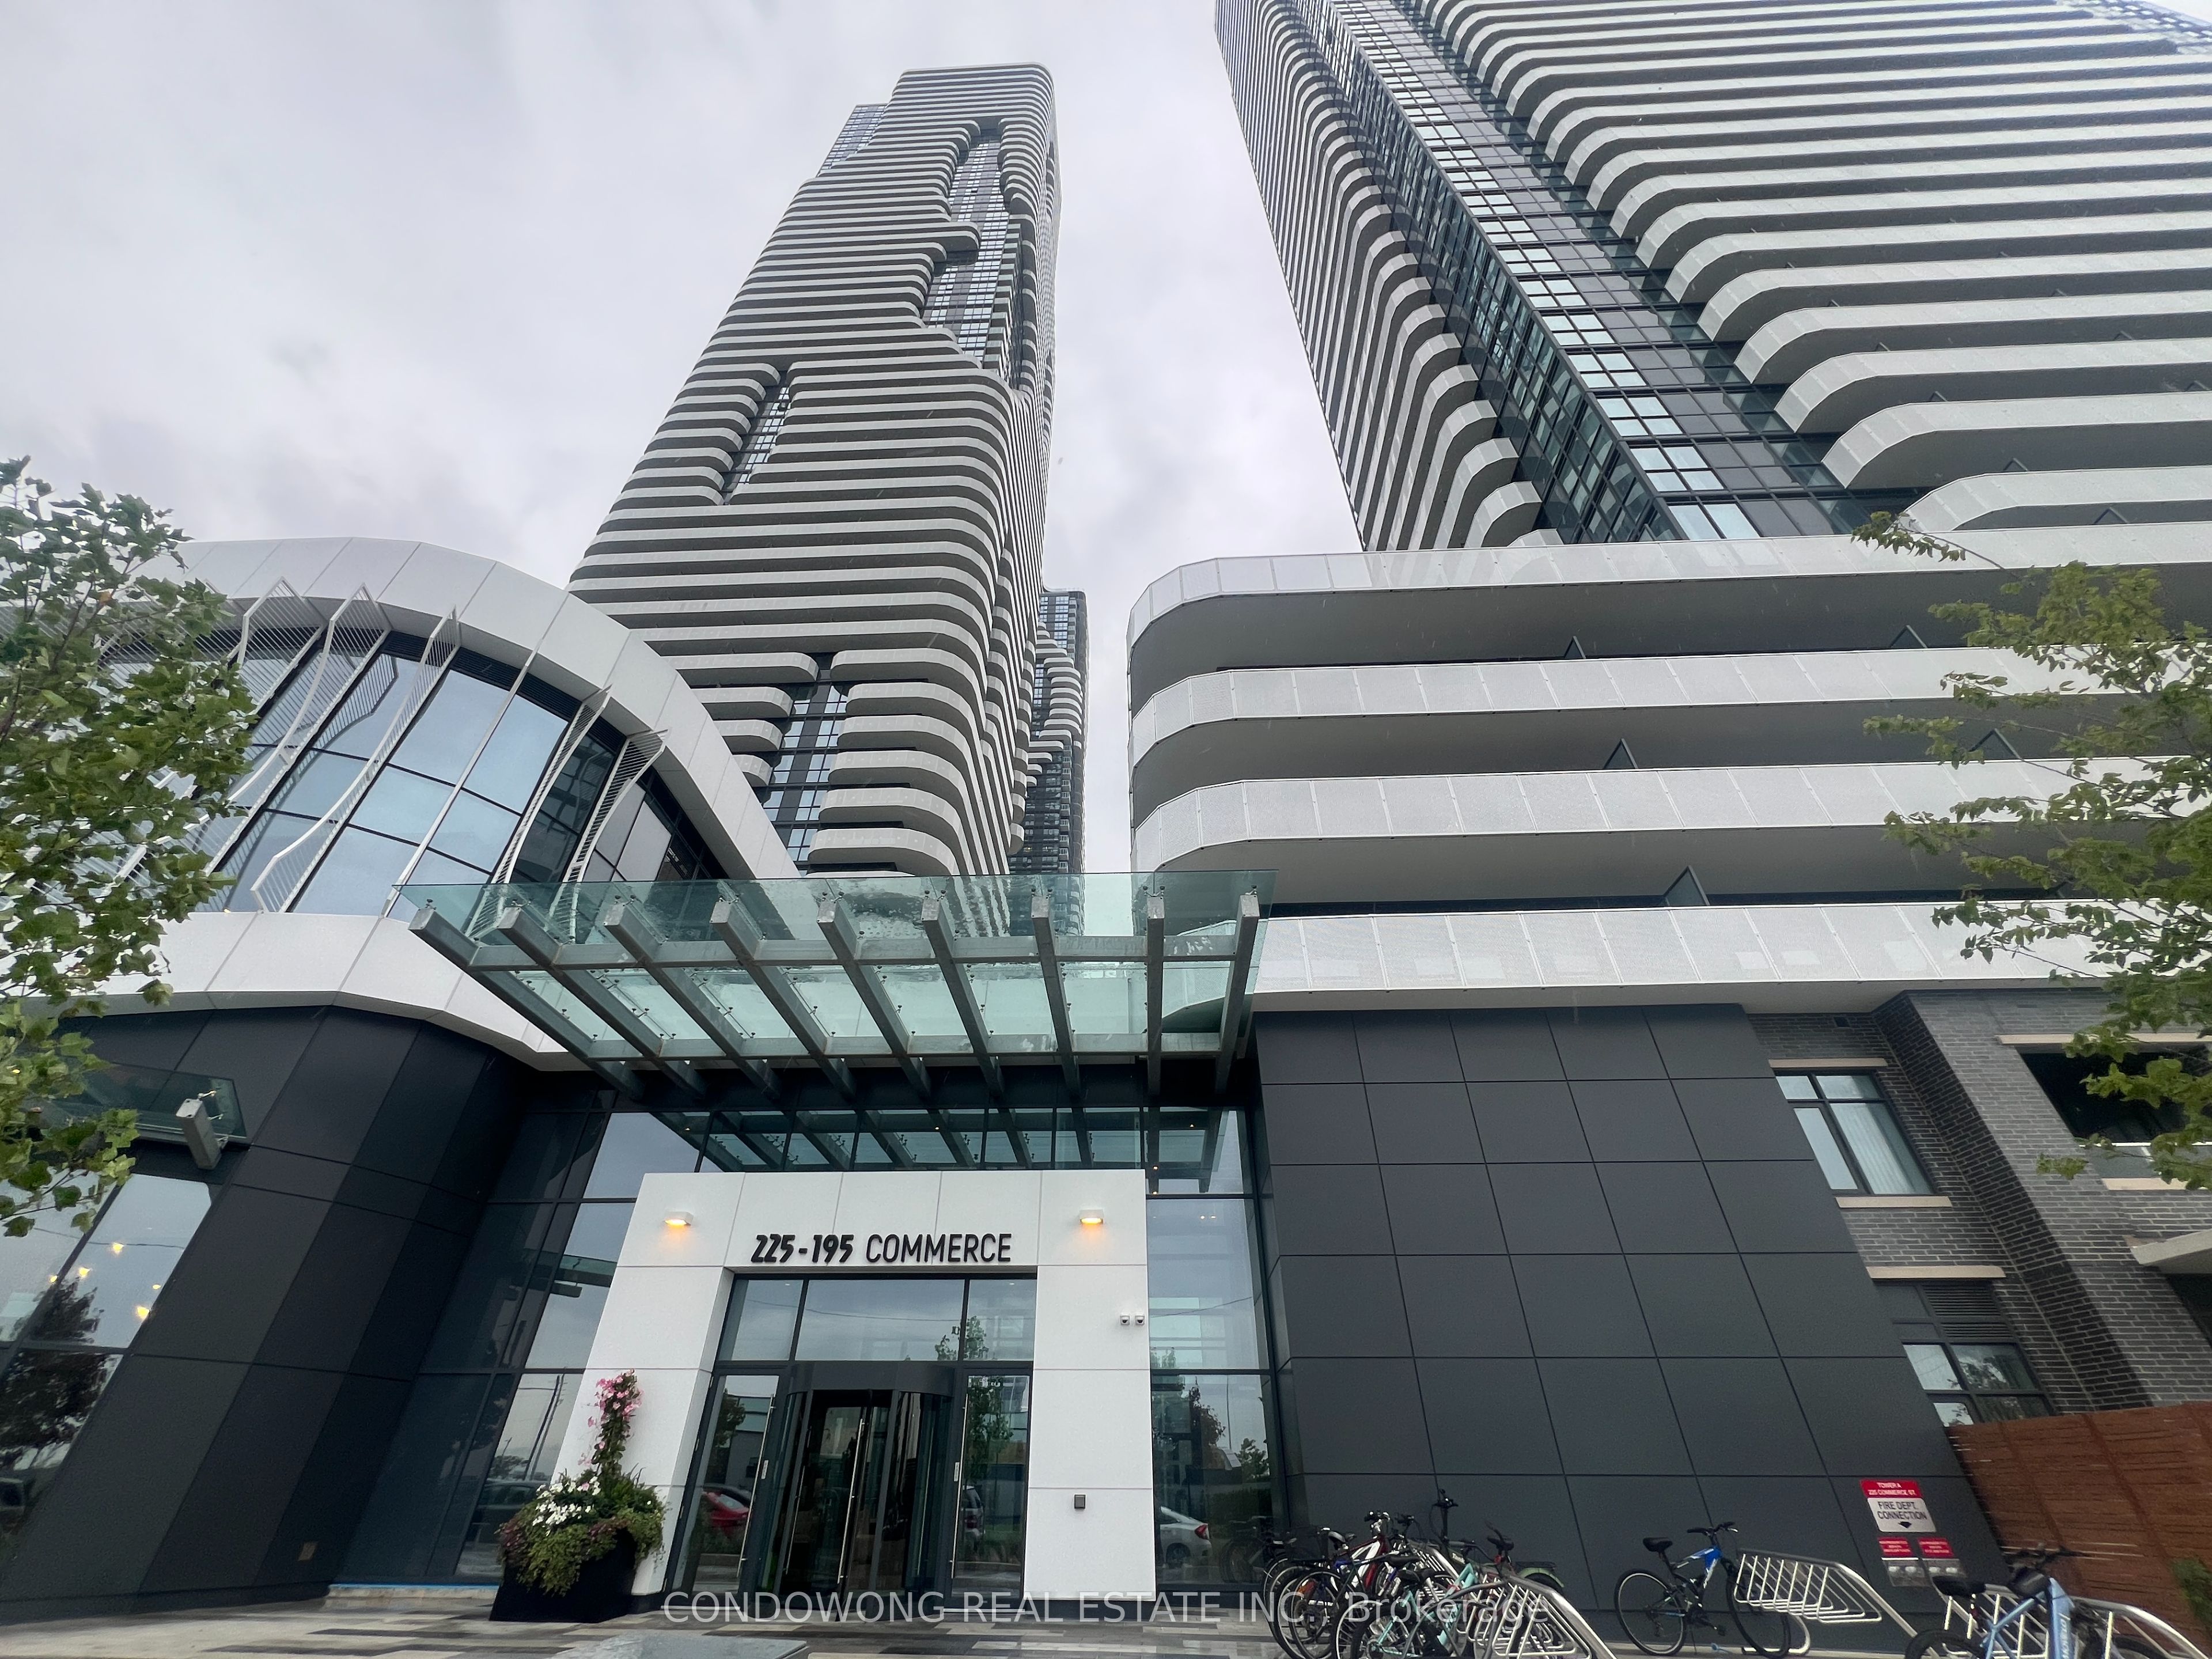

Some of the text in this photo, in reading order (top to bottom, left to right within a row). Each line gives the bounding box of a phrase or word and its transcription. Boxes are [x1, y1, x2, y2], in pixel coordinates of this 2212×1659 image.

[751, 1233, 1012, 1263] 225-195 COMMERCE
[1878, 1501, 1896, 1510] FIRE
[1877, 1511, 1927, 1520] CONNECTION
